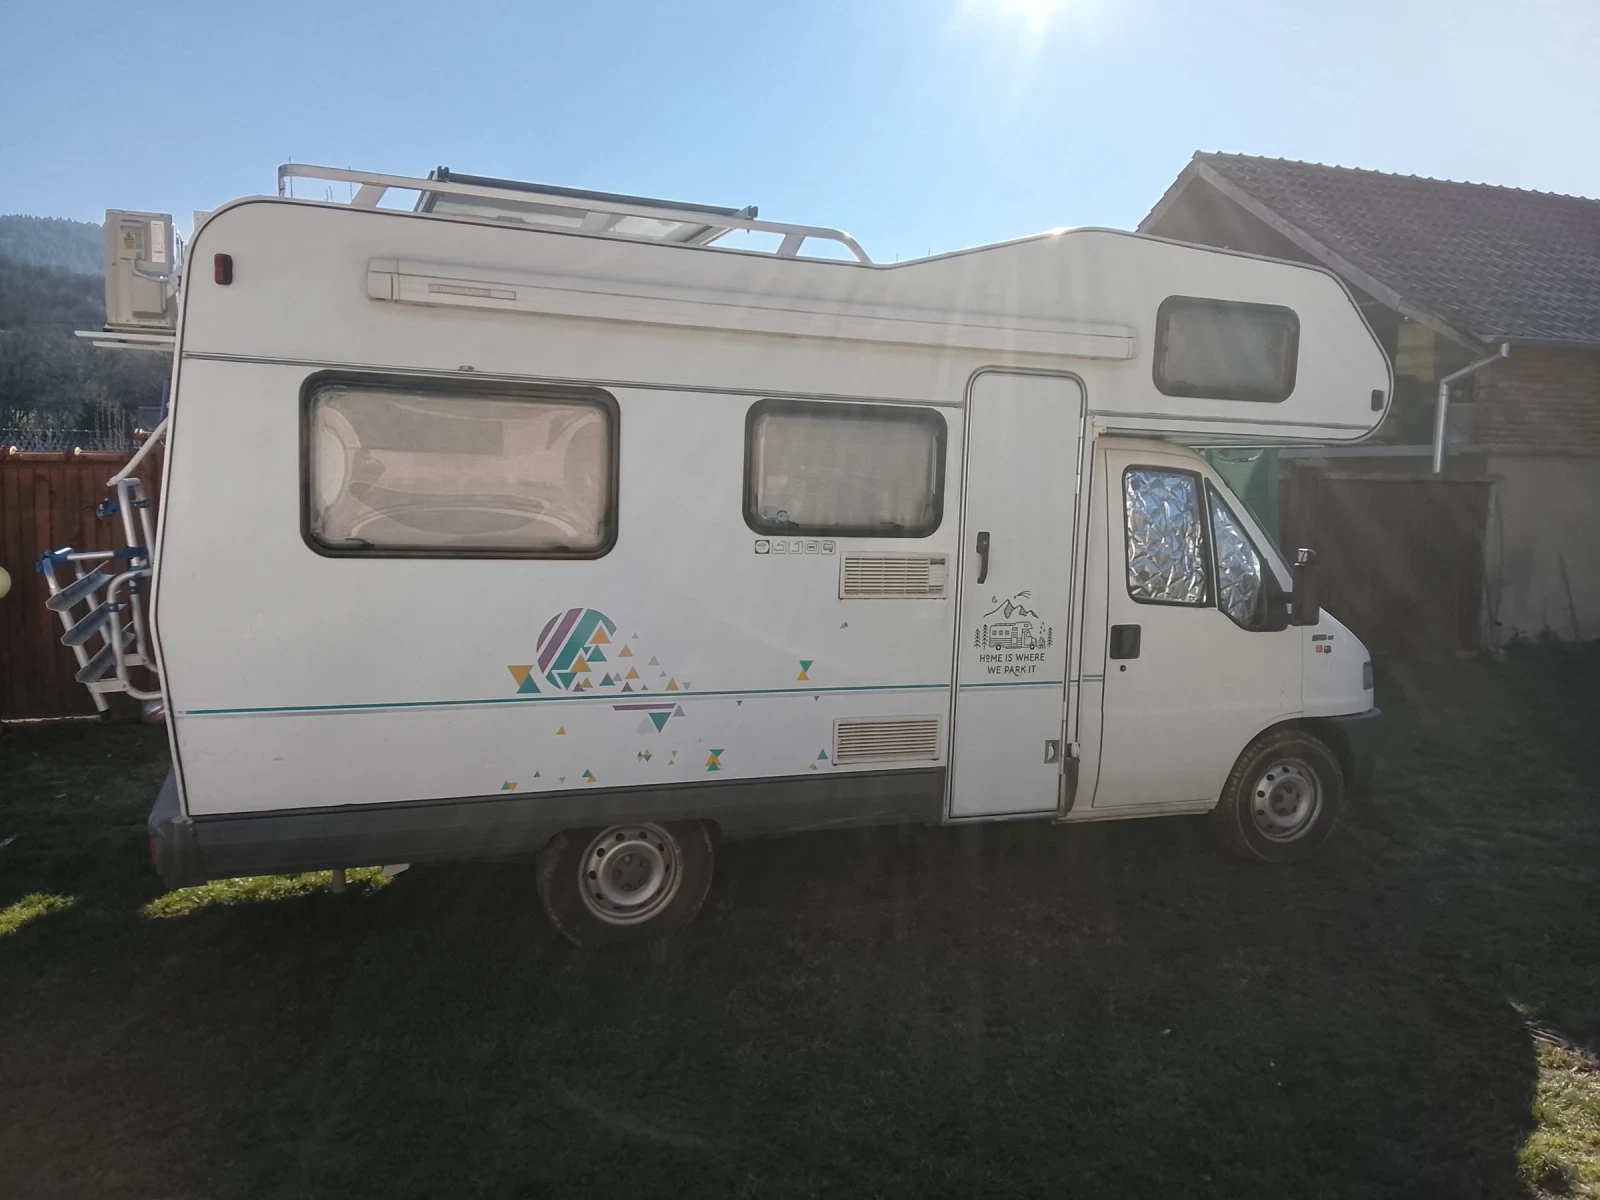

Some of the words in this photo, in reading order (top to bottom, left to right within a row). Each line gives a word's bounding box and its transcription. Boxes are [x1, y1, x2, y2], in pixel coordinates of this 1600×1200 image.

[979, 654, 1003, 663] HOME
[1005, 653, 1013, 662] IS
[1015, 653, 1045, 662] WHERE
[987, 666, 1002, 674] WE
[1004, 665, 1027, 676] PARK
[1028, 665, 1036, 673] IT
